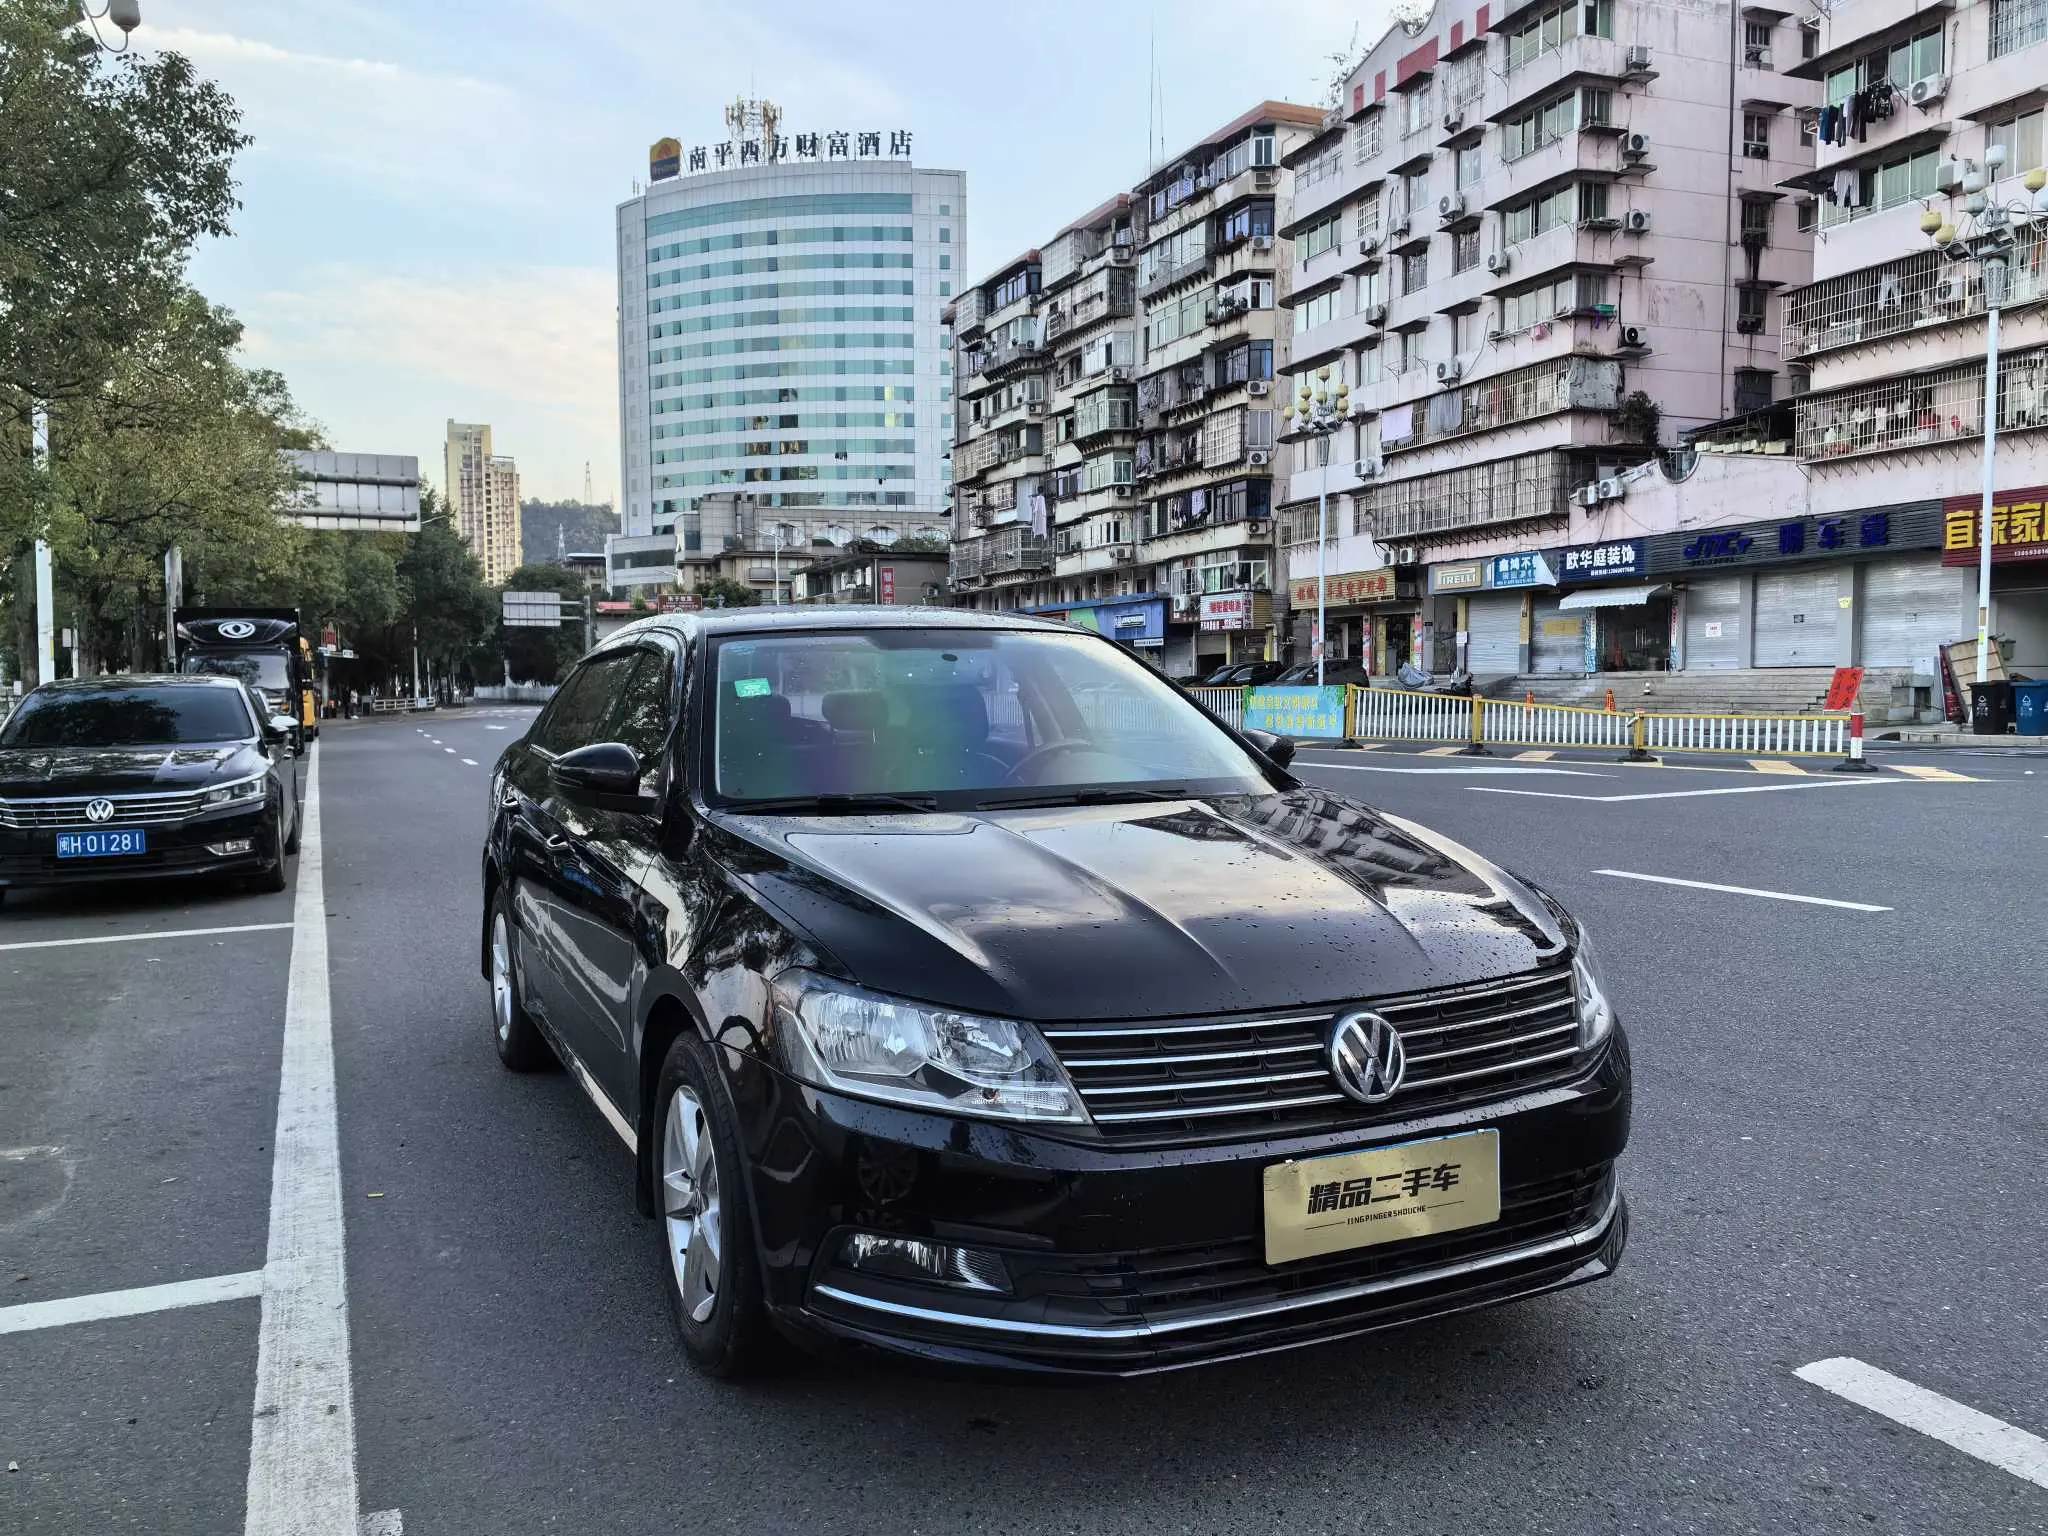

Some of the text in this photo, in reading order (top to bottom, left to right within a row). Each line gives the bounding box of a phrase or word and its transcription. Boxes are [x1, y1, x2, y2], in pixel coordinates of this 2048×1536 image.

[1945, 502, 2048, 549] 宜家家
[1566, 544, 1635, 570] 欧华庭装饰
[1307, 1163, 1463, 1214] 精品二手车
